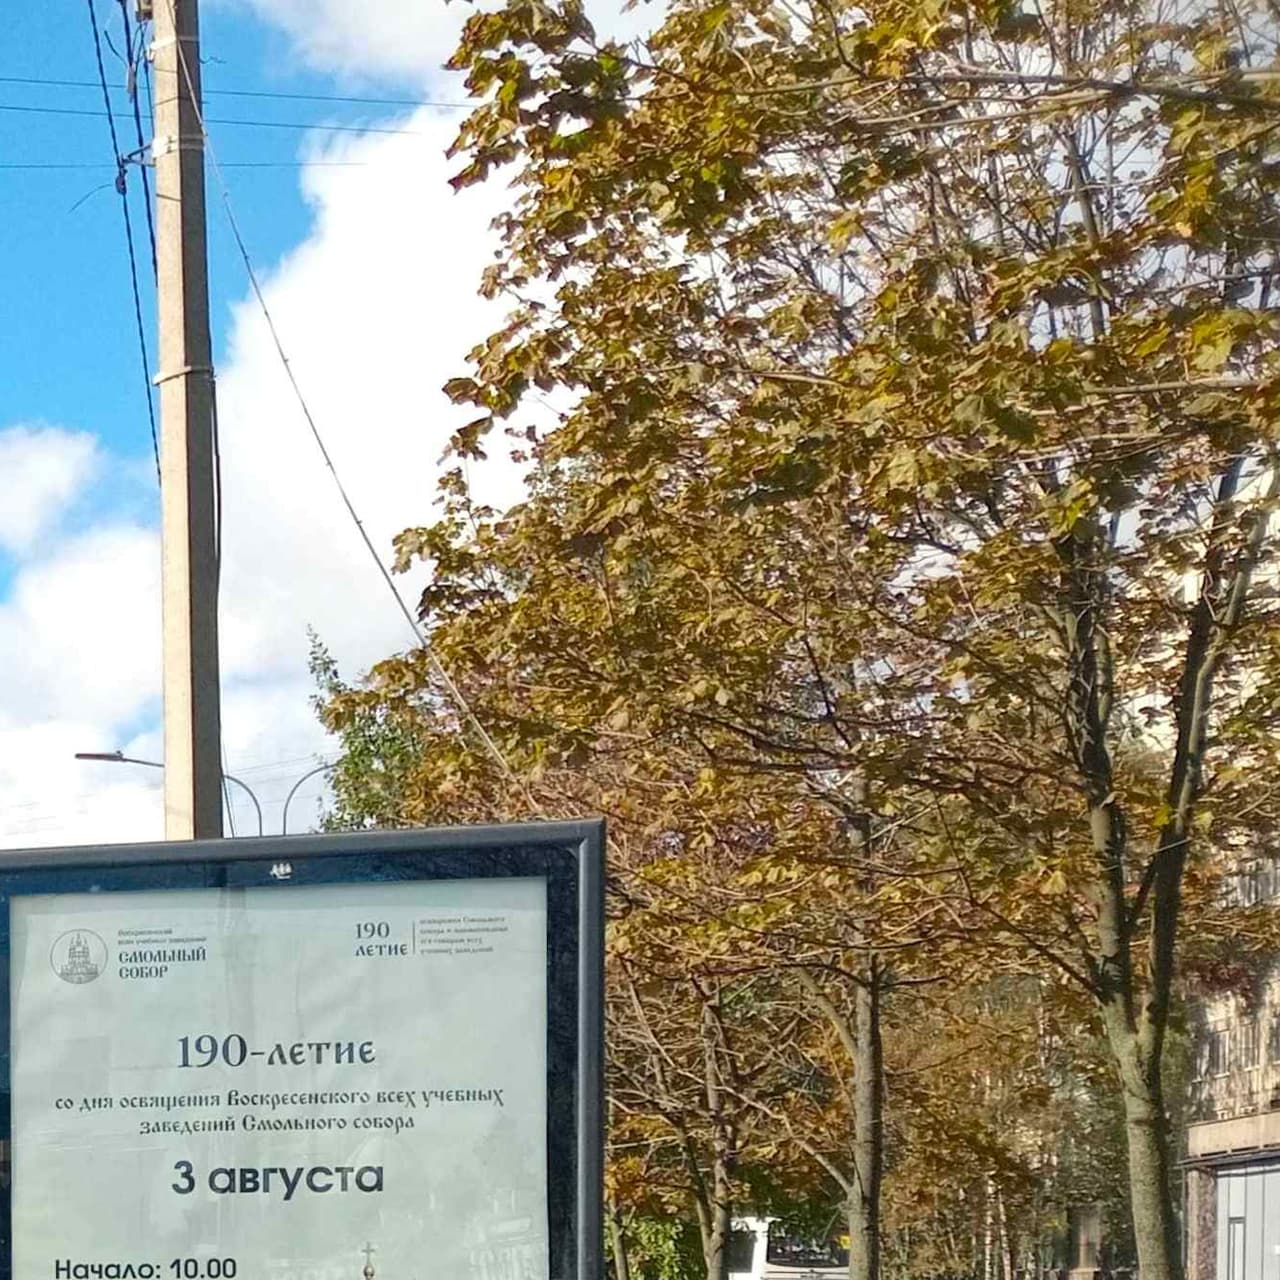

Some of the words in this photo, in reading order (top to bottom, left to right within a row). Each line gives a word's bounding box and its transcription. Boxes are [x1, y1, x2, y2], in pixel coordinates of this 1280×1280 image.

[356, 921, 390, 940] 190
[118, 945, 206, 964] СМОЛЬНЫЙ
[118, 965, 169, 980] СОБОР
[177, 1033, 376, 1069] 190-летие
[55, 1097, 74, 1110] со
[79, 1097, 113, 1113] дня
[119, 1094, 221, 1113] освящения
[227, 1089, 371, 1111] Воскресенского
[376, 1090, 417, 1109] всех
[421, 1088, 505, 1109] учебных
[139, 1116, 236, 1136] заведений
[241, 1114, 348, 1132] Смольного
[352, 1116, 415, 1135] собора
[171, 1160, 196, 1195] 3
[207, 1165, 384, 1202] августа
[55, 1258, 161, 1280] Начало:
[169, 1257, 237, 1280] 10.00
